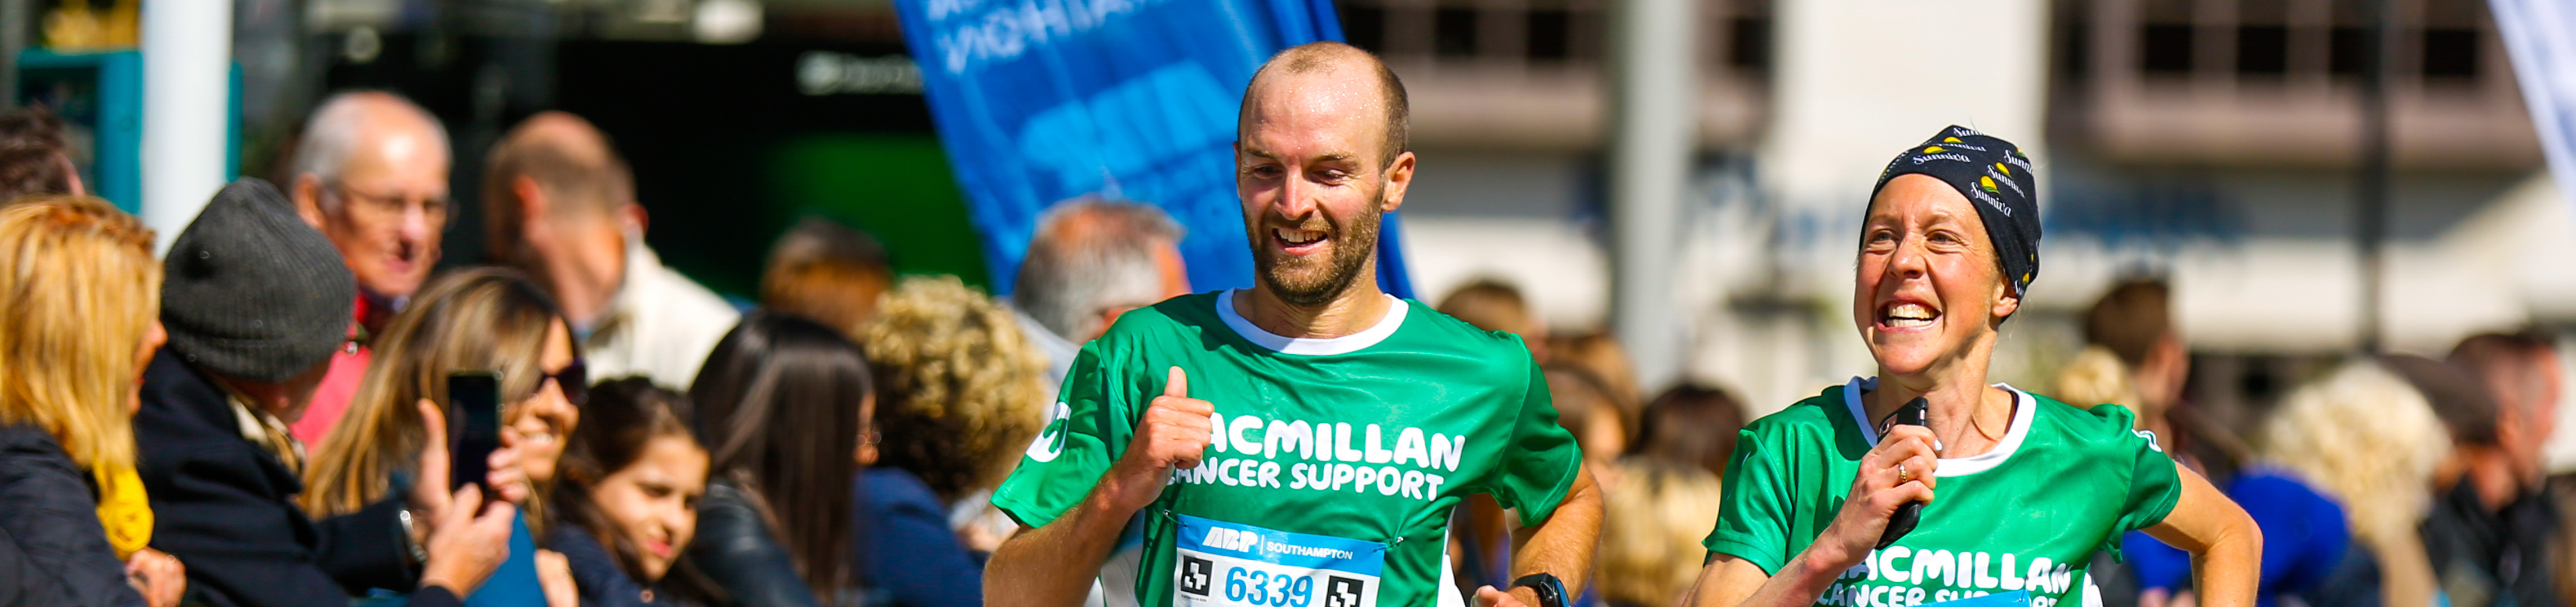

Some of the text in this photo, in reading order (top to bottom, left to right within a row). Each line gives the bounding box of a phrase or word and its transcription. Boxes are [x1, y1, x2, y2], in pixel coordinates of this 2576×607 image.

[1912, 152, 1971, 165] Sunniva
[1970, 181, 2012, 218] Sunniva
[1209, 412, 1466, 472] ACMILLAN
[1167, 457, 1444, 502] ANCER SUPPORT
[1202, 526, 1353, 560] ABP SOUTHAMPTON
[1225, 566, 1314, 607] 6339
[1838, 545, 2073, 594] ACMILLAN
